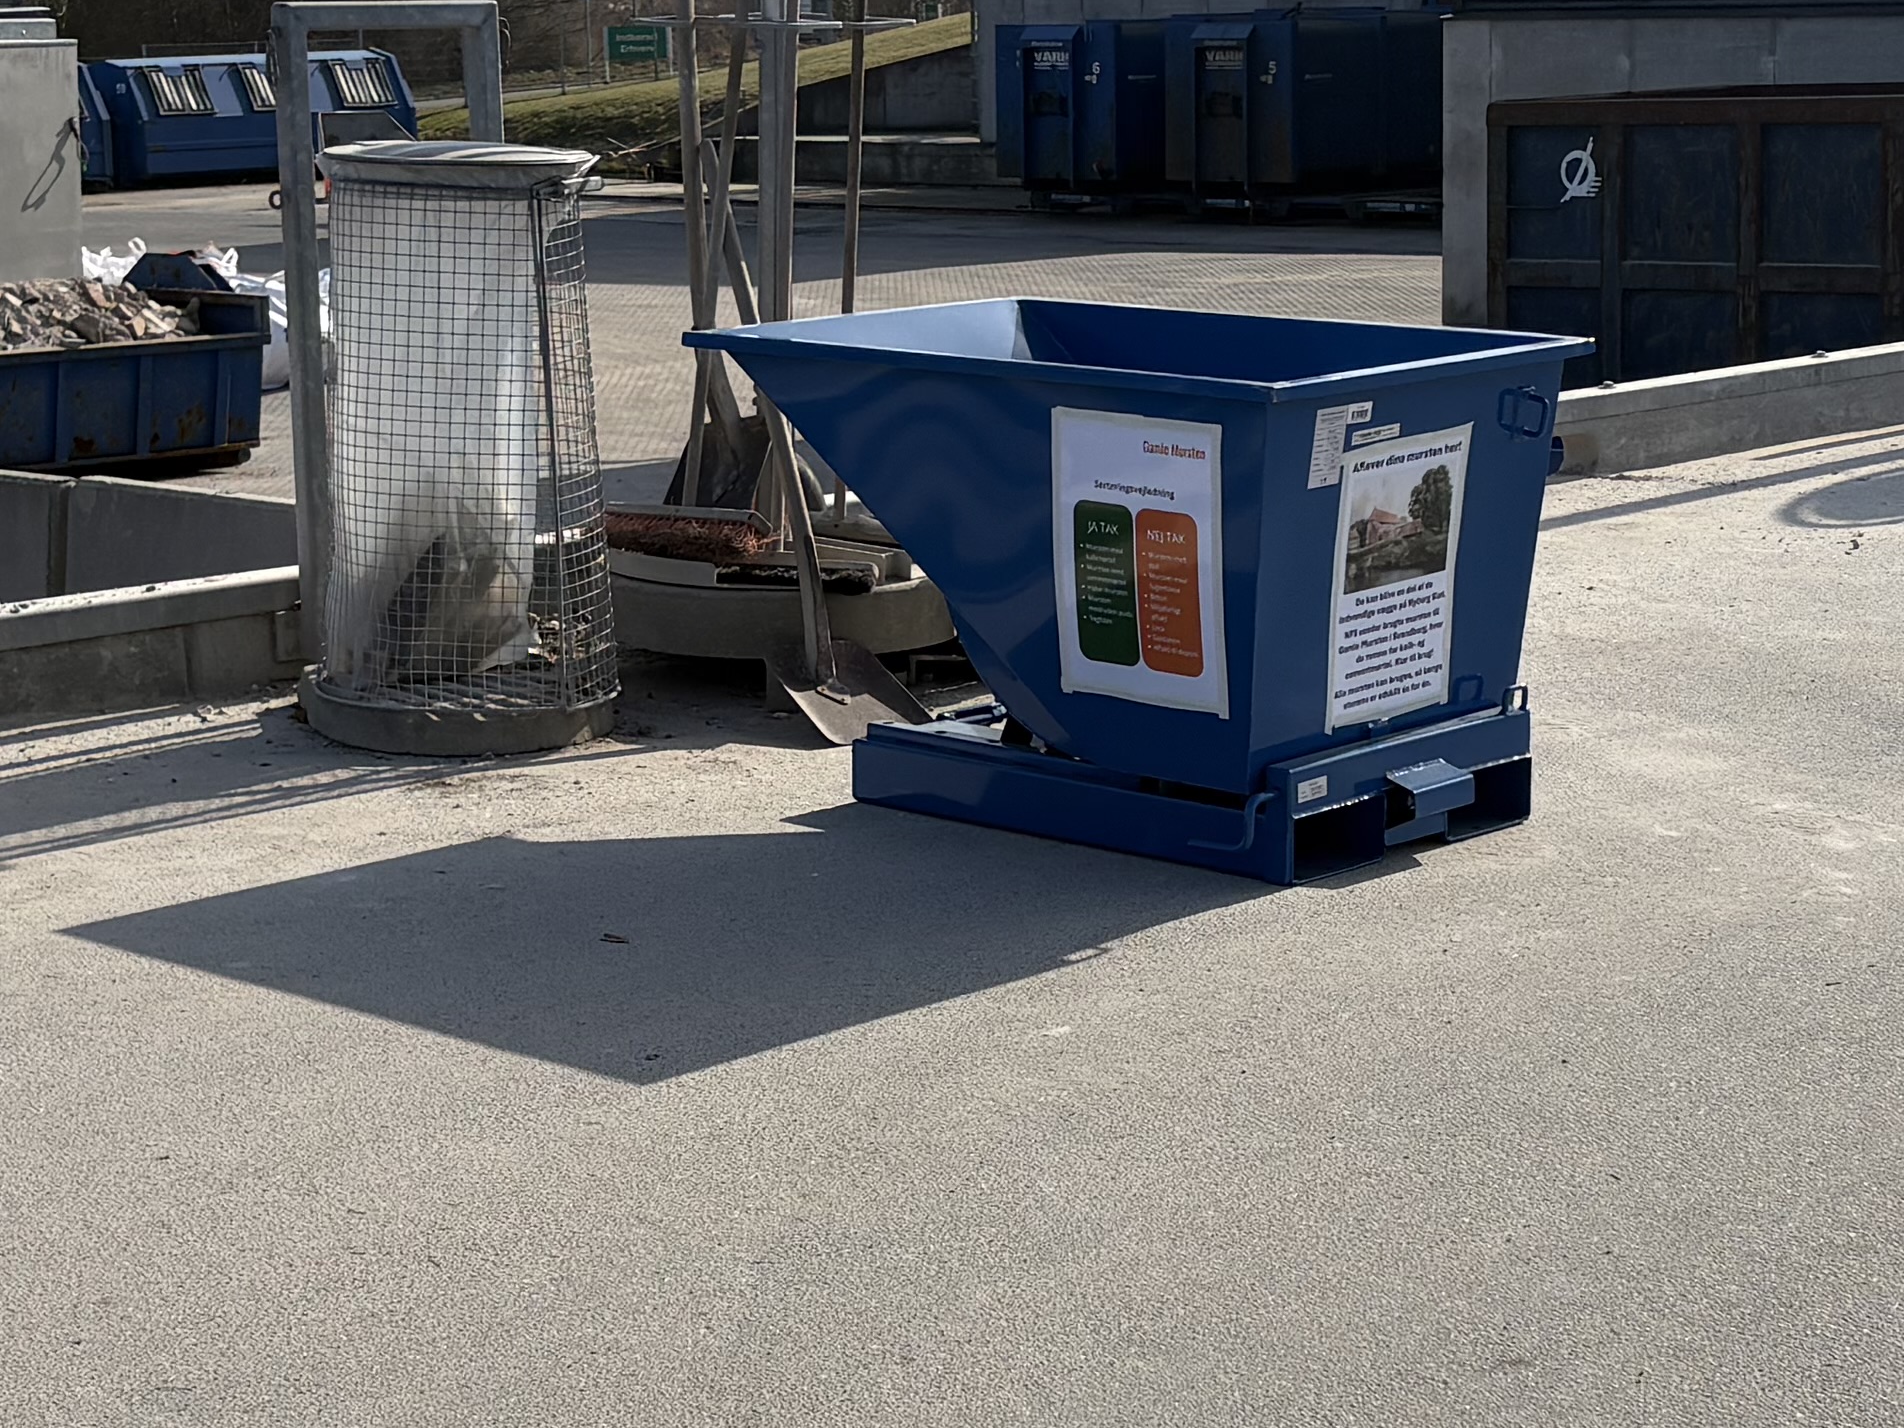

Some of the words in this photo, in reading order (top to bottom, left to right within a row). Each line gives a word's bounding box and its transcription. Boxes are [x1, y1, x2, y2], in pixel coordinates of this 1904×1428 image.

[1092, 61, 1101, 74] 6
[1268, 61, 1277, 74] 5
[1099, 521, 1119, 536] TAK
[1166, 531, 1186, 545] TAK
